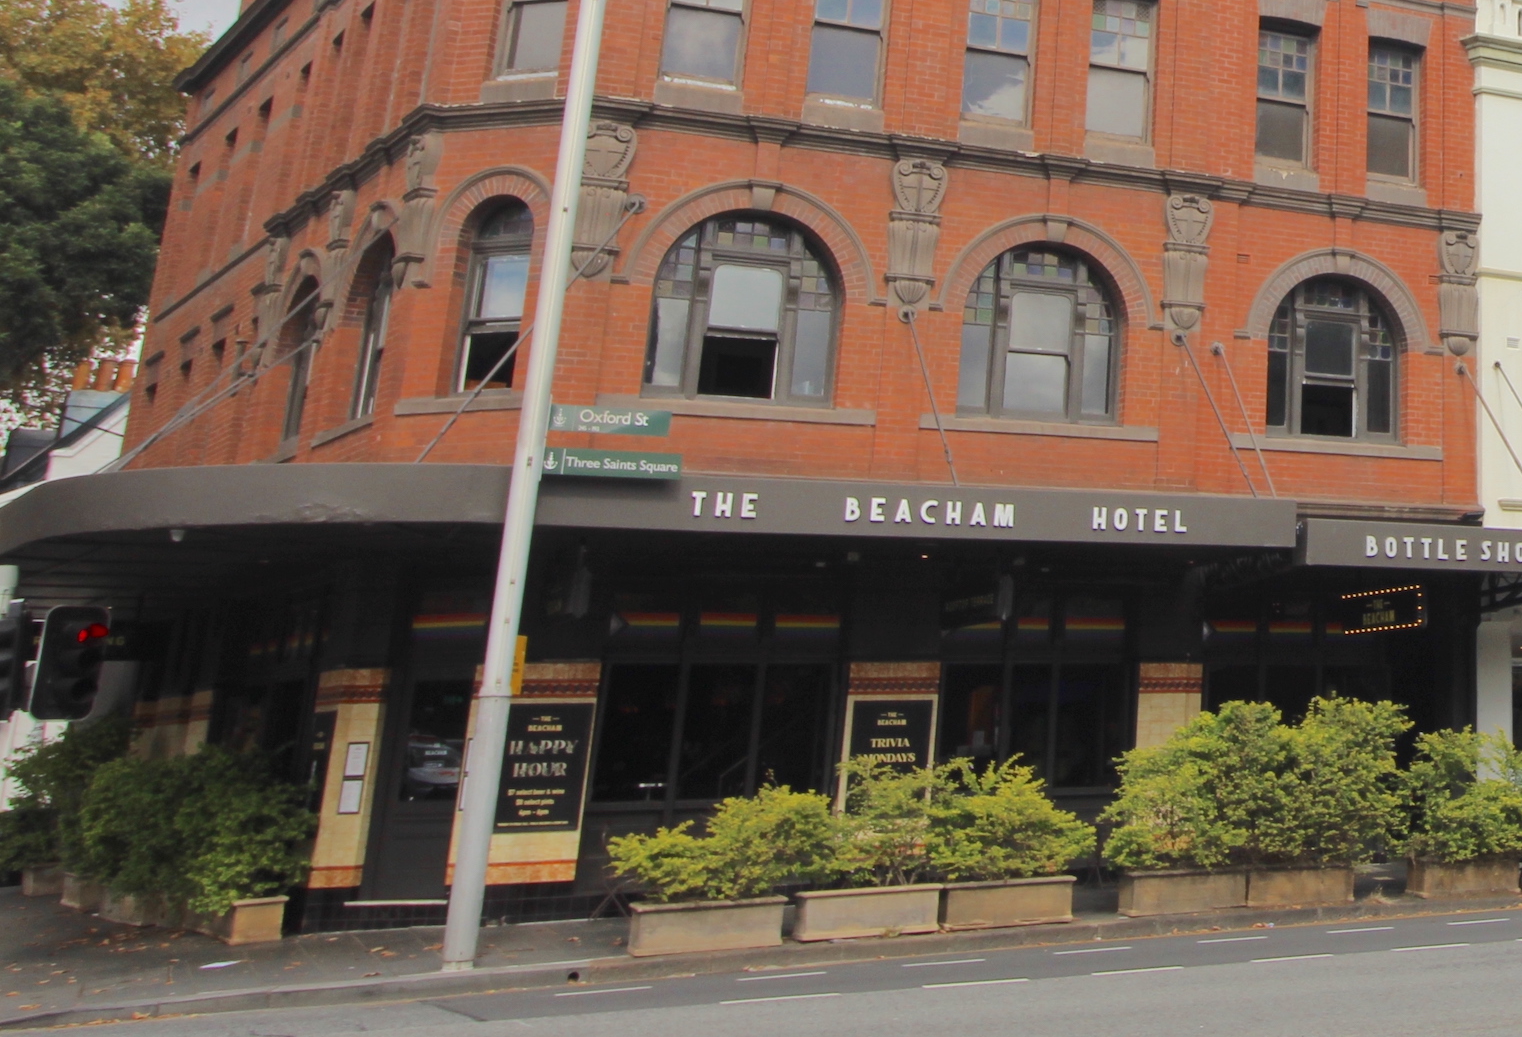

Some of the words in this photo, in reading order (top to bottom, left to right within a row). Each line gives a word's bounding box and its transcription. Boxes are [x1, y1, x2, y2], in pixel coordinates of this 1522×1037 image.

[580, 409, 631, 425] Oxford
[634, 413, 649, 426] St
[566, 456, 600, 469] Three
[603, 458, 636, 470] Saints
[639, 460, 678, 473] Square
[691, 491, 759, 519] THE
[844, 496, 1016, 528] BEACHAM
[1092, 507, 1188, 534] HOTEL
[1365, 535, 1468, 561] BOTTLE
[509, 740, 579, 755] HAPPY
[870, 738, 910, 748] TRIVIA
[513, 762, 568, 777] HOUR
